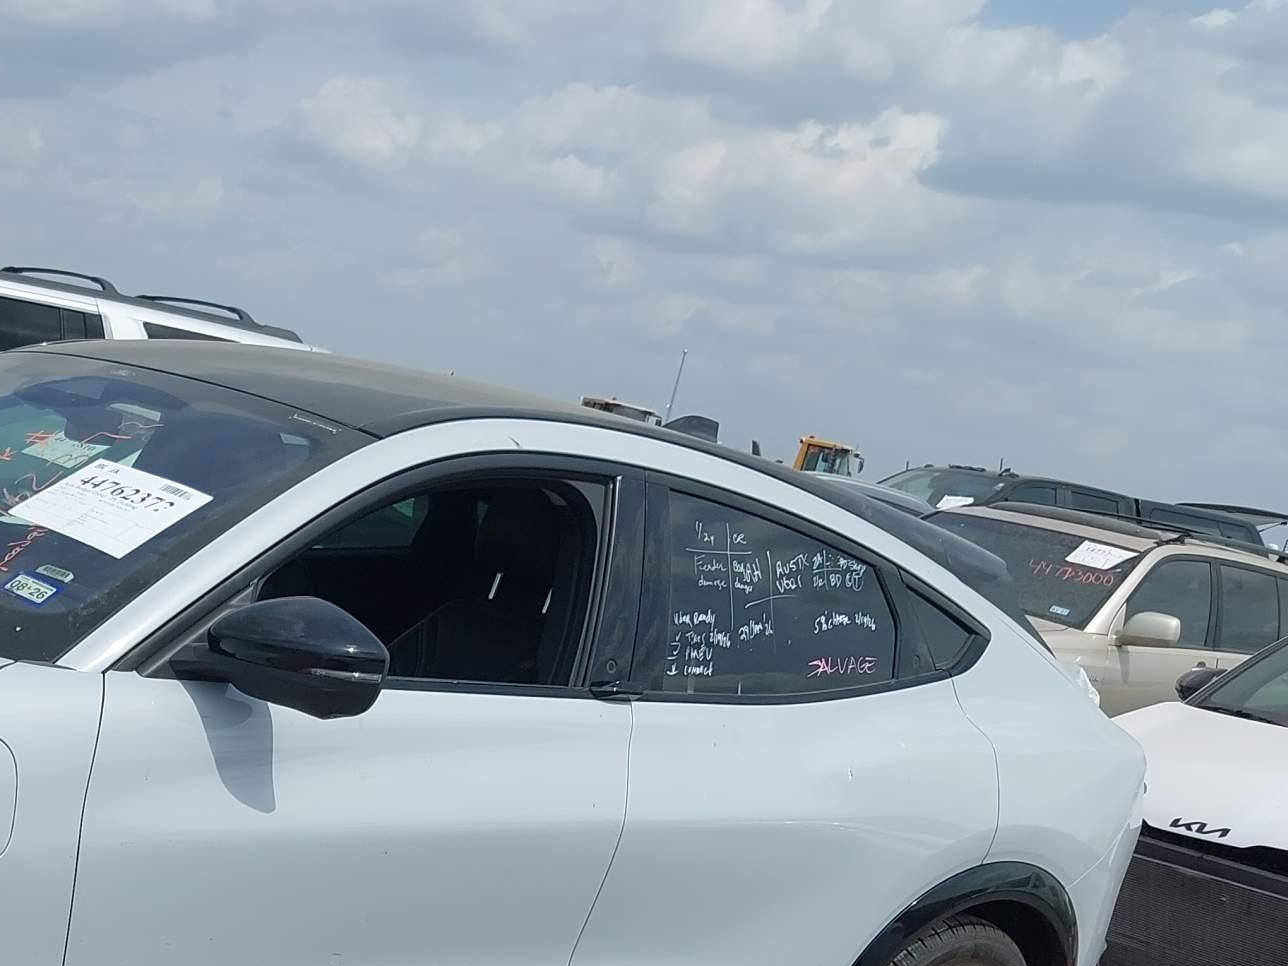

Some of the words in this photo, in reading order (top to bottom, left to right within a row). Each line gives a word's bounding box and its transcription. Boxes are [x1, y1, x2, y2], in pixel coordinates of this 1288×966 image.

[10, 579, 28, 592] 08
[28, 586, 49, 600] 26
[807, 655, 878, 678] SALVAGE
